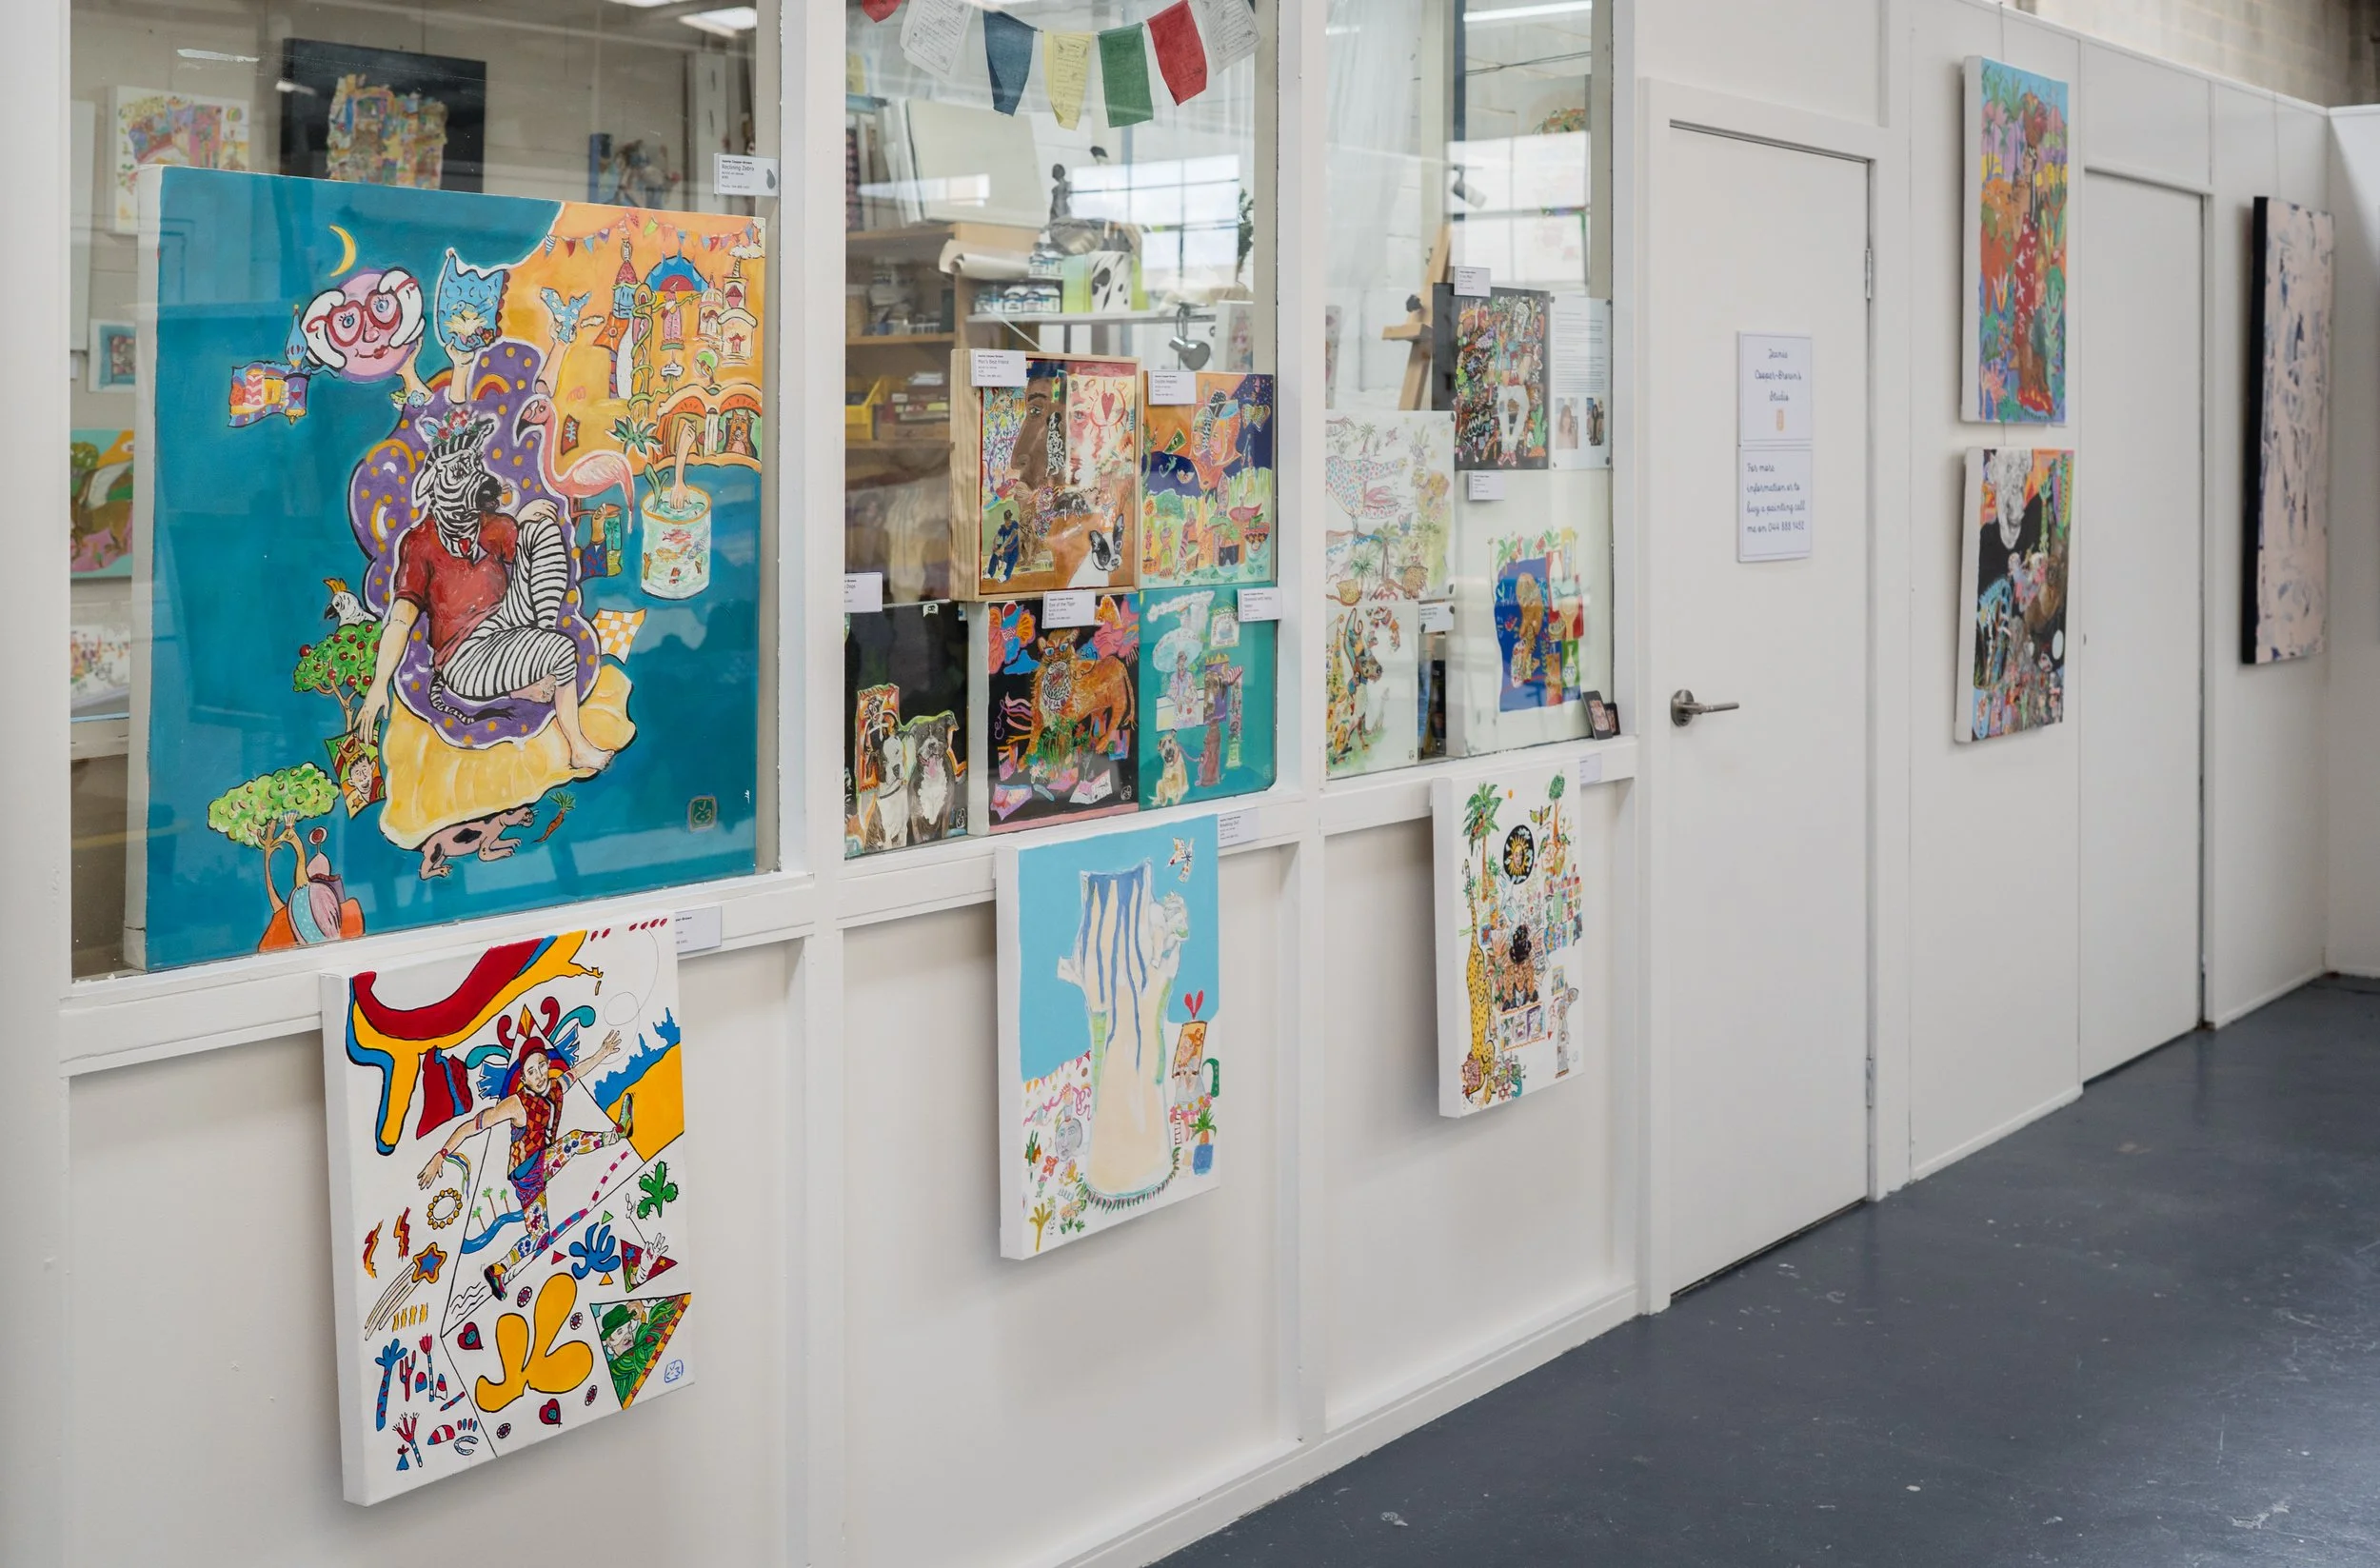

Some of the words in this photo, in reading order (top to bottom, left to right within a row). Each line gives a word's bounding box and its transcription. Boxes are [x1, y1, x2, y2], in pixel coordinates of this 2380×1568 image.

[1747, 463, 1758, 472] For
[1746, 483, 1786, 495] information
[1794, 482, 1800, 491] to
[1746, 501, 1760, 517] buy
[1766, 503, 1794, 515] painting
[1795, 500, 1805, 511] call
